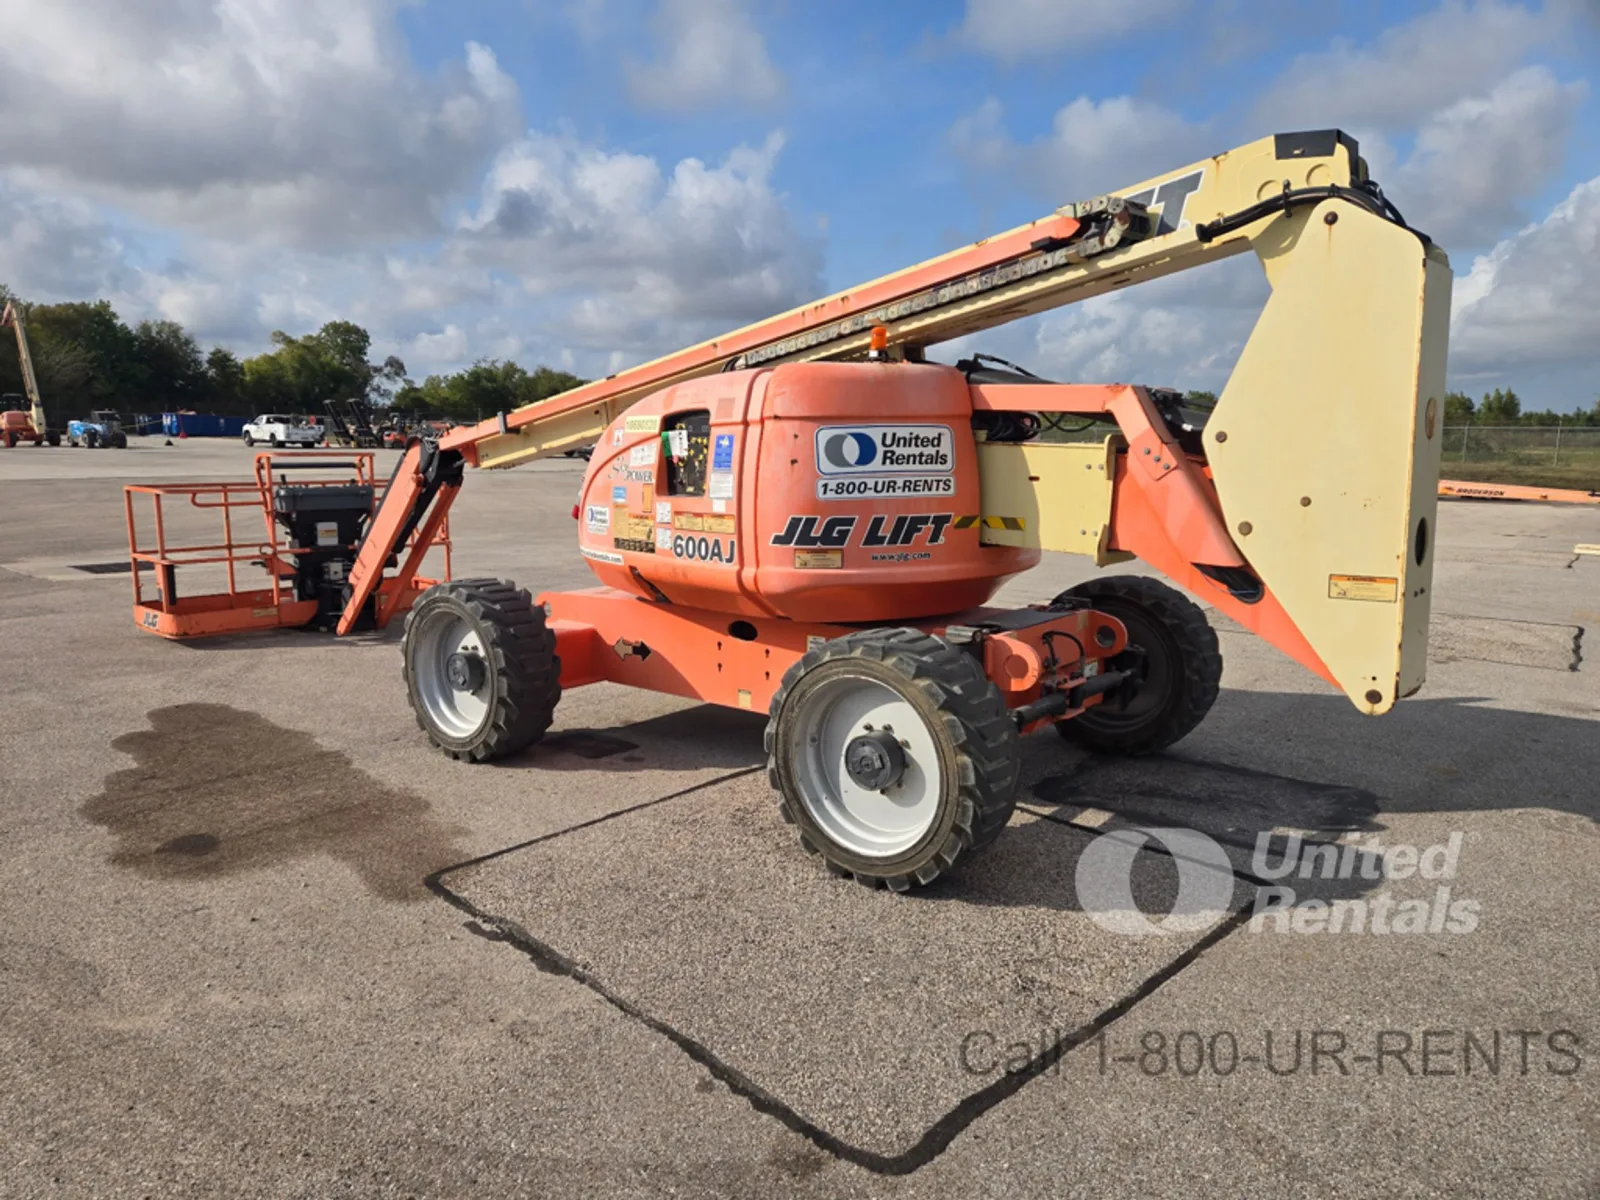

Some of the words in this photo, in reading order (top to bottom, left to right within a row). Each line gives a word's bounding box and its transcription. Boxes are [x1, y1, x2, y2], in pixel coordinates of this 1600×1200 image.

[881, 432, 942, 447] United
[881, 450, 948, 466] Rentals
[820, 479, 952, 496] 1-800-UR-RENTS
[1456, 488, 1505, 496] BRODERSON
[770, 516, 858, 546] JLG
[861, 514, 953, 546] LIFT
[674, 535, 735, 563] 600AJ
[871, 551, 931, 562] www.jlg.com
